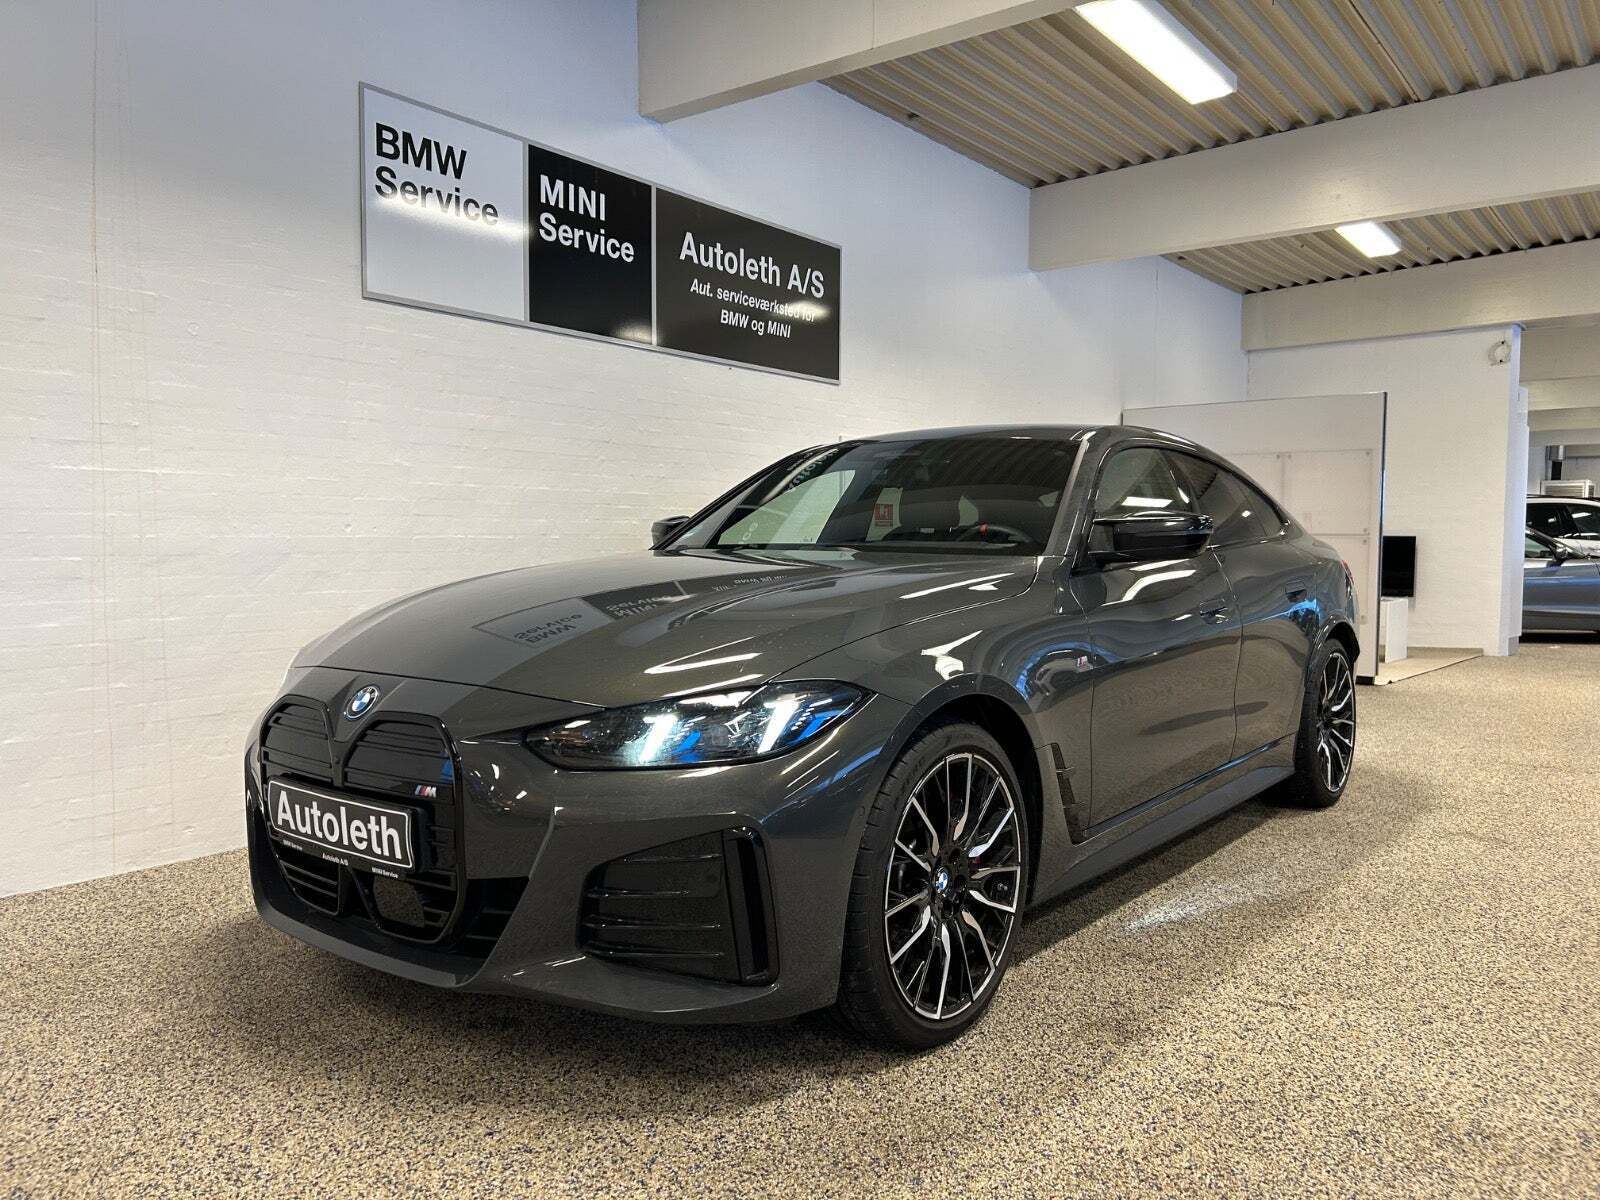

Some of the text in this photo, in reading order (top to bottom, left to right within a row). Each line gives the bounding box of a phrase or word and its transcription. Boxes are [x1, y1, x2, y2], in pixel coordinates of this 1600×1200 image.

[375, 122, 467, 180] BMW
[375, 165, 499, 226] Service
[539, 174, 606, 221] MINI
[539, 212, 634, 262] Service
[679, 231, 825, 298] Autoleth A/S
[690, 278, 816, 323] Aut. serviceværksted for
[720, 308, 791, 338] BMW og MINI
[277, 790, 403, 860] Autoleth
